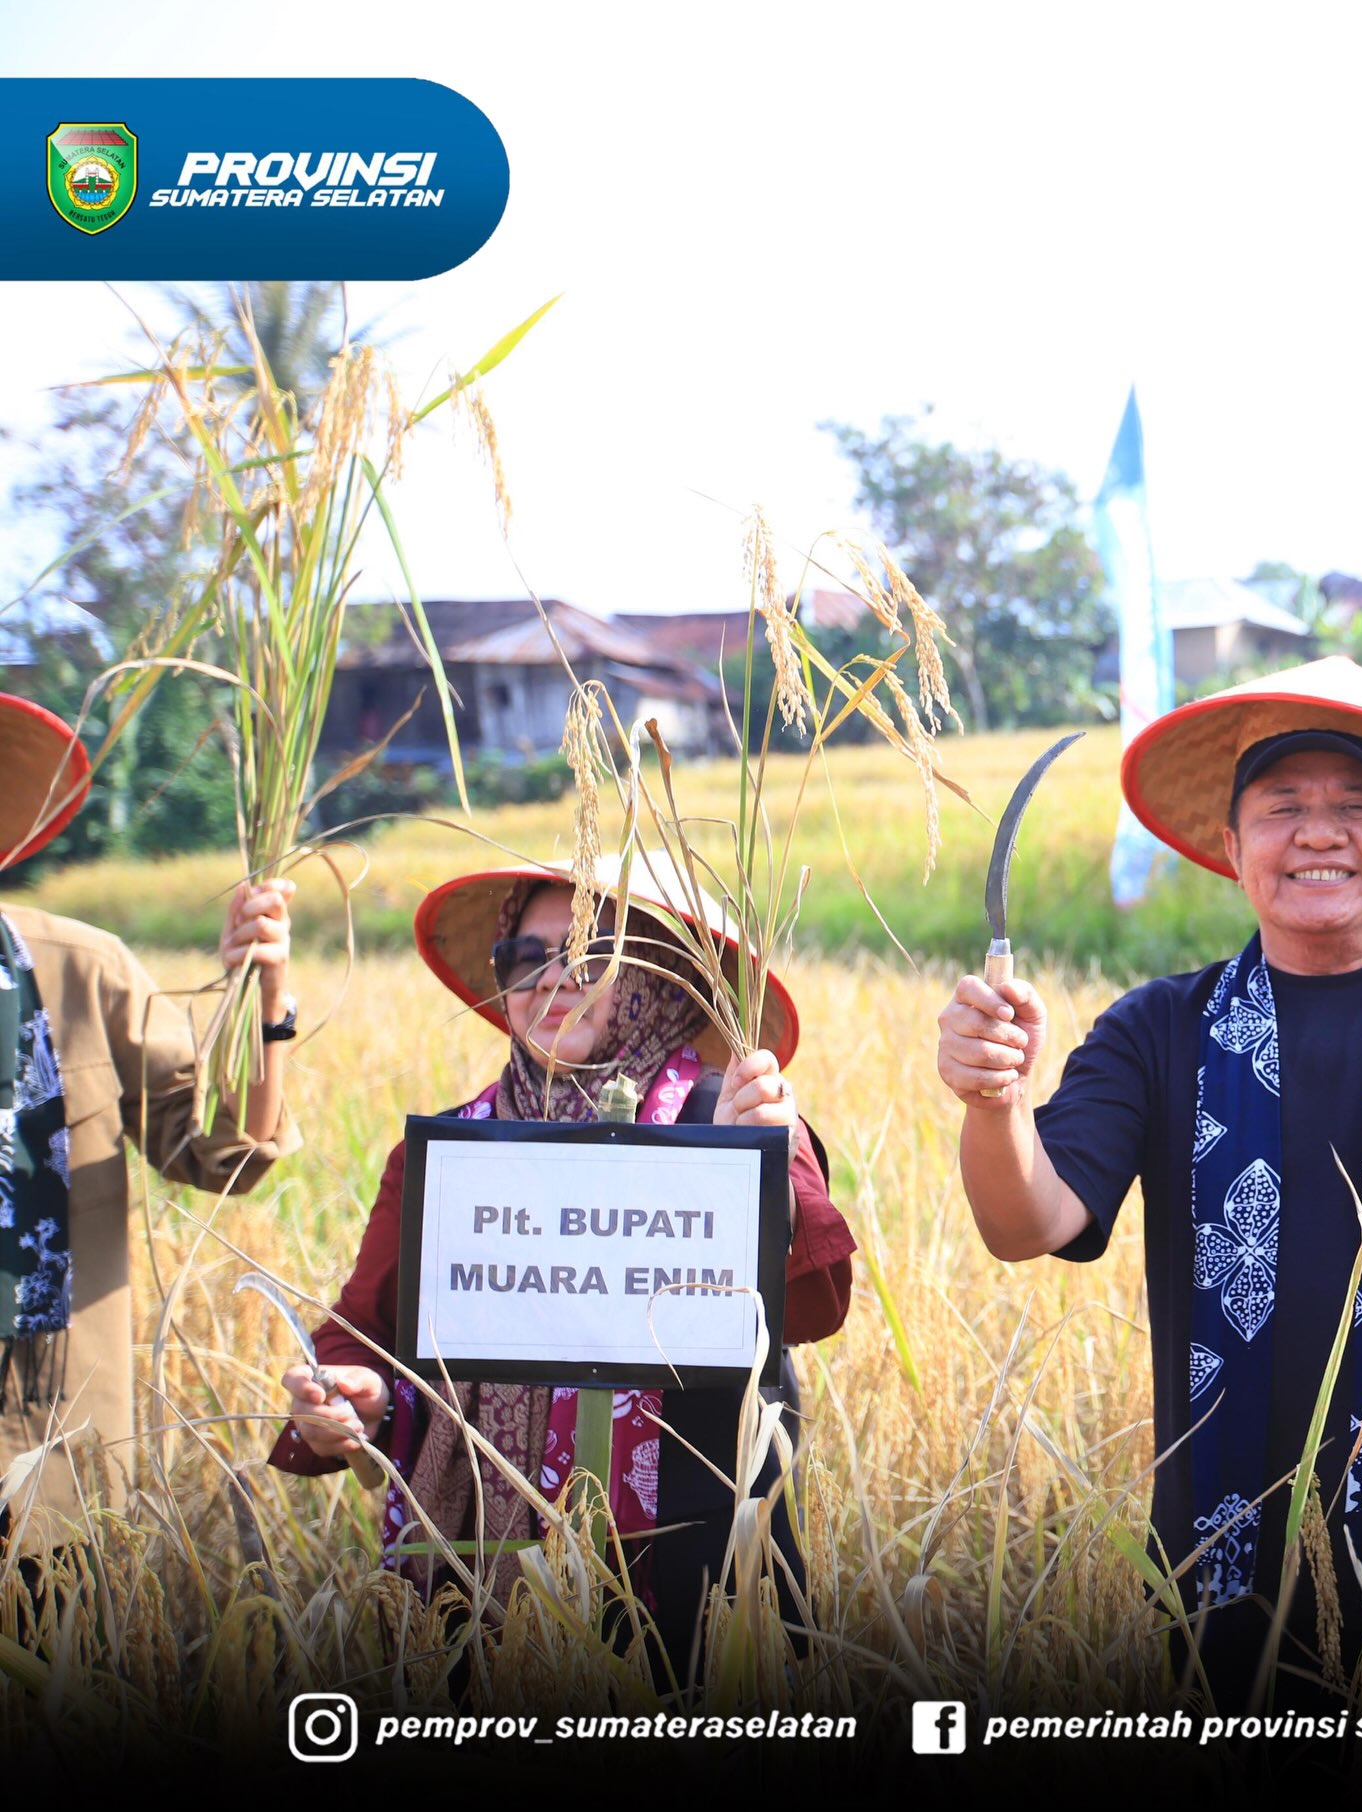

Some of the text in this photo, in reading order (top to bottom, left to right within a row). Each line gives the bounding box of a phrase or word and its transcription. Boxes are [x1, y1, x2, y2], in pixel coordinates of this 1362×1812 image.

[473, 1206, 715, 1239] Plt. BUPATI
[450, 1263, 735, 1297] MUARA ENIM
